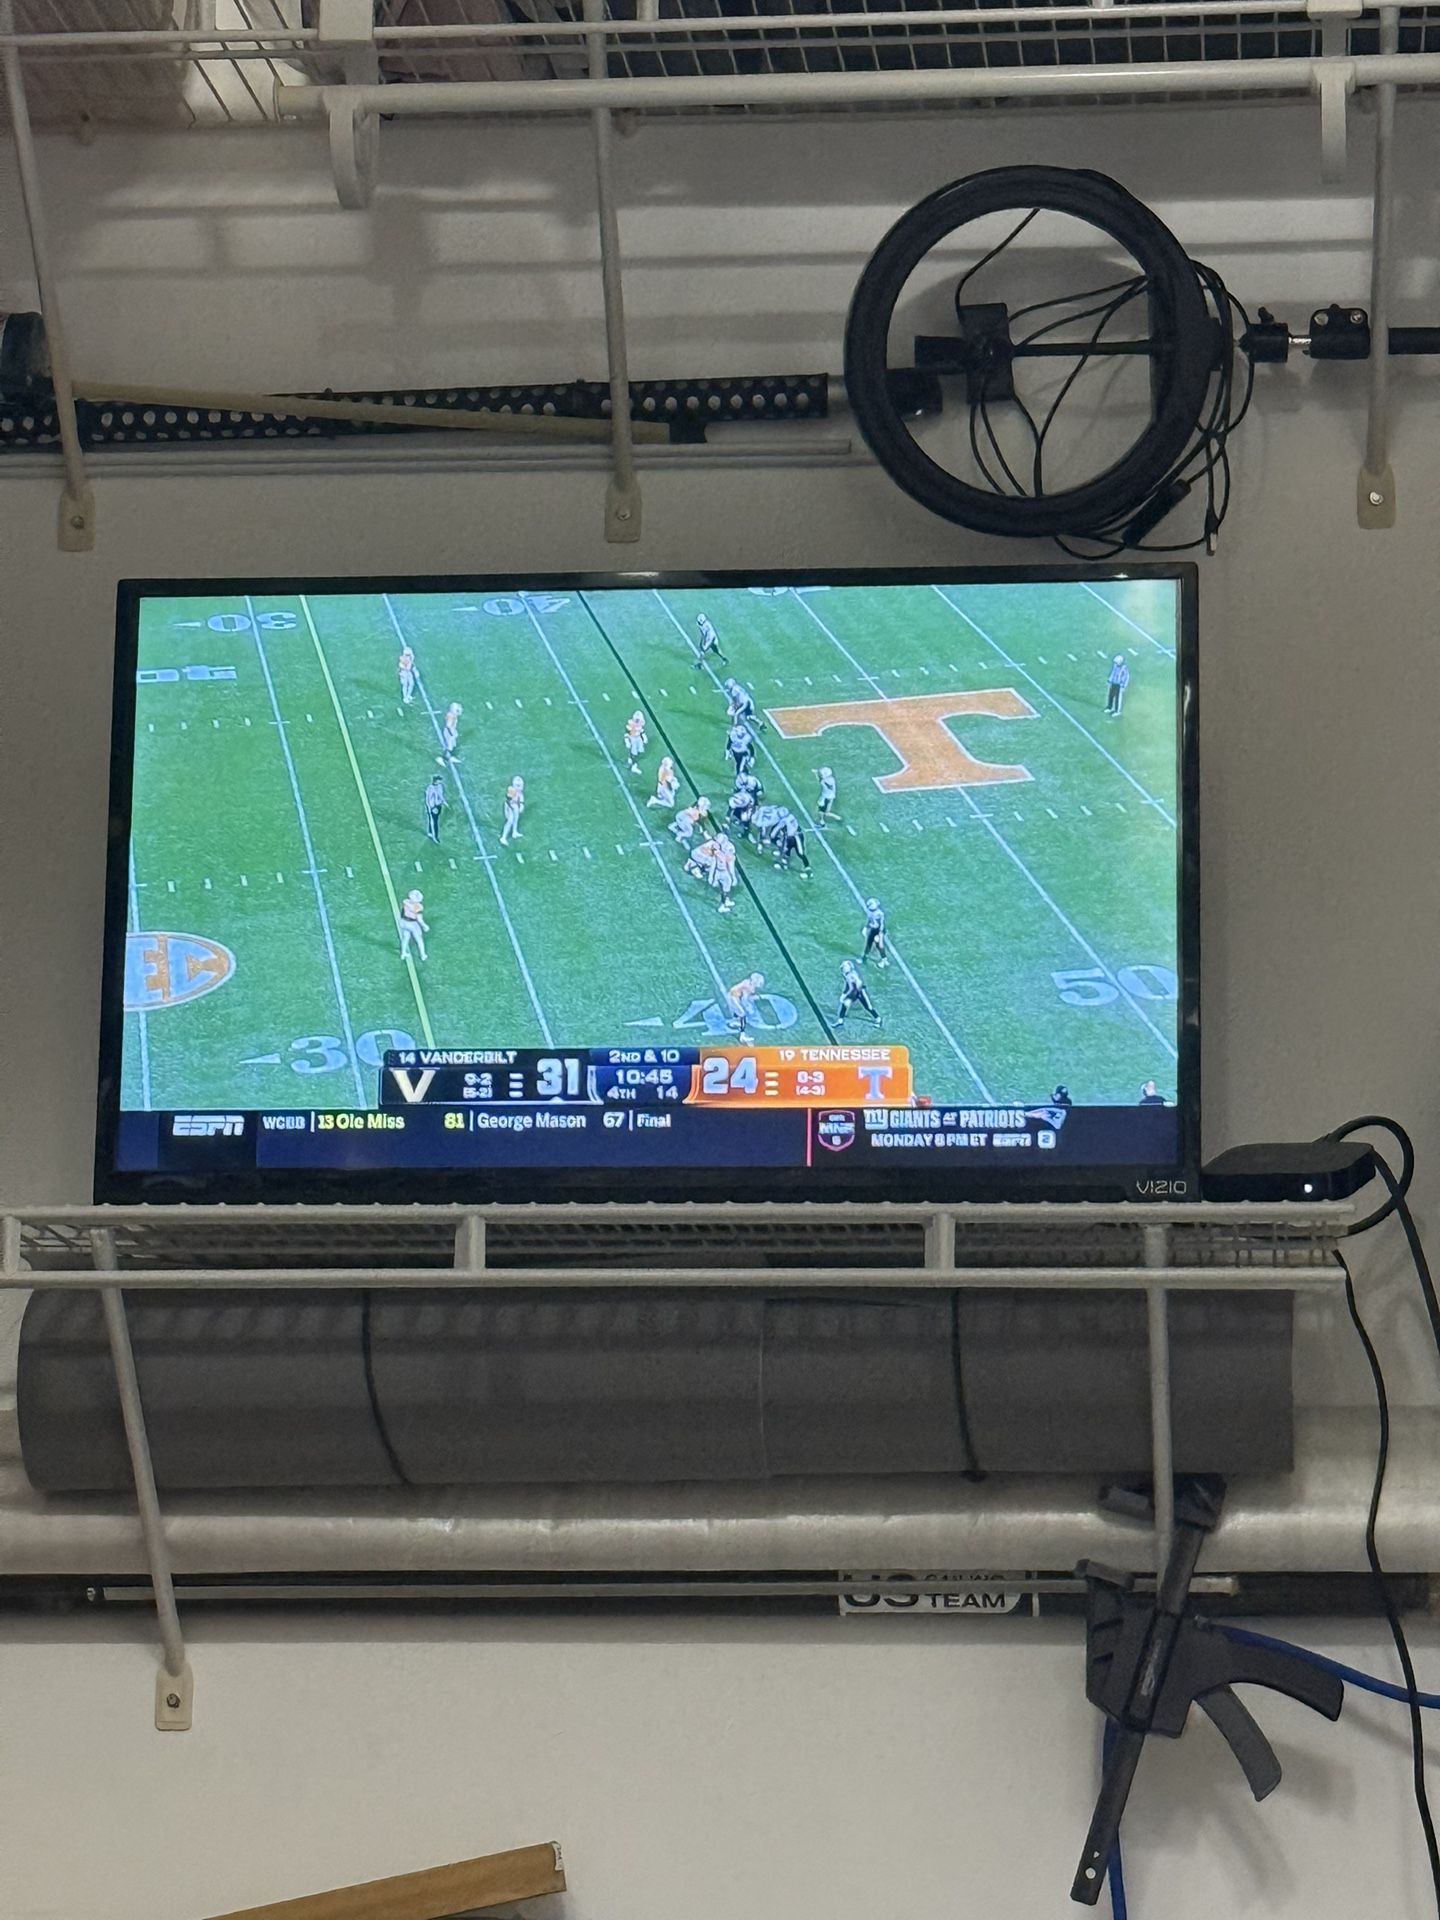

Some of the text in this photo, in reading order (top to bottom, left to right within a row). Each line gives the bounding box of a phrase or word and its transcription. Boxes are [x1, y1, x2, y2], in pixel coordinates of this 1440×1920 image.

[1050, 965, 1178, 1006] 50
[290, 1028, 417, 1074] 30
[399, 1051, 518, 1065] 14 VANDERBILT
[608, 1049, 680, 1064] 2ND & 10
[779, 1049, 891, 1062] 19 TENNESSEE
[536, 1058, 580, 1096] 31
[615, 1068, 674, 1085] 10:45
[702, 1056, 758, 1095] 24
[858, 1066, 893, 1100] T
[388, 1067, 441, 1102] V
[607, 1086, 679, 1100] 4TH 14
[172, 1115, 245, 1136] ESPN
[318, 1113, 405, 1129] 13 Ole Miss
[444, 1112, 465, 1129] 81
[477, 1112, 587, 1131] George Mason
[603, 1111, 625, 1128] 67
[637, 1113, 671, 1128] Final
[890, 1109, 941, 1129] GIANTS
[960, 1109, 1027, 1128] PATRIOTS
[871, 1133, 933, 1147] MONDAY
[946, 1133, 969, 1147] PM
[970, 1133, 988, 1147] ET
[1136, 1180, 1187, 1194] VIZIO
[923, 1592, 1006, 1609] TEAM
